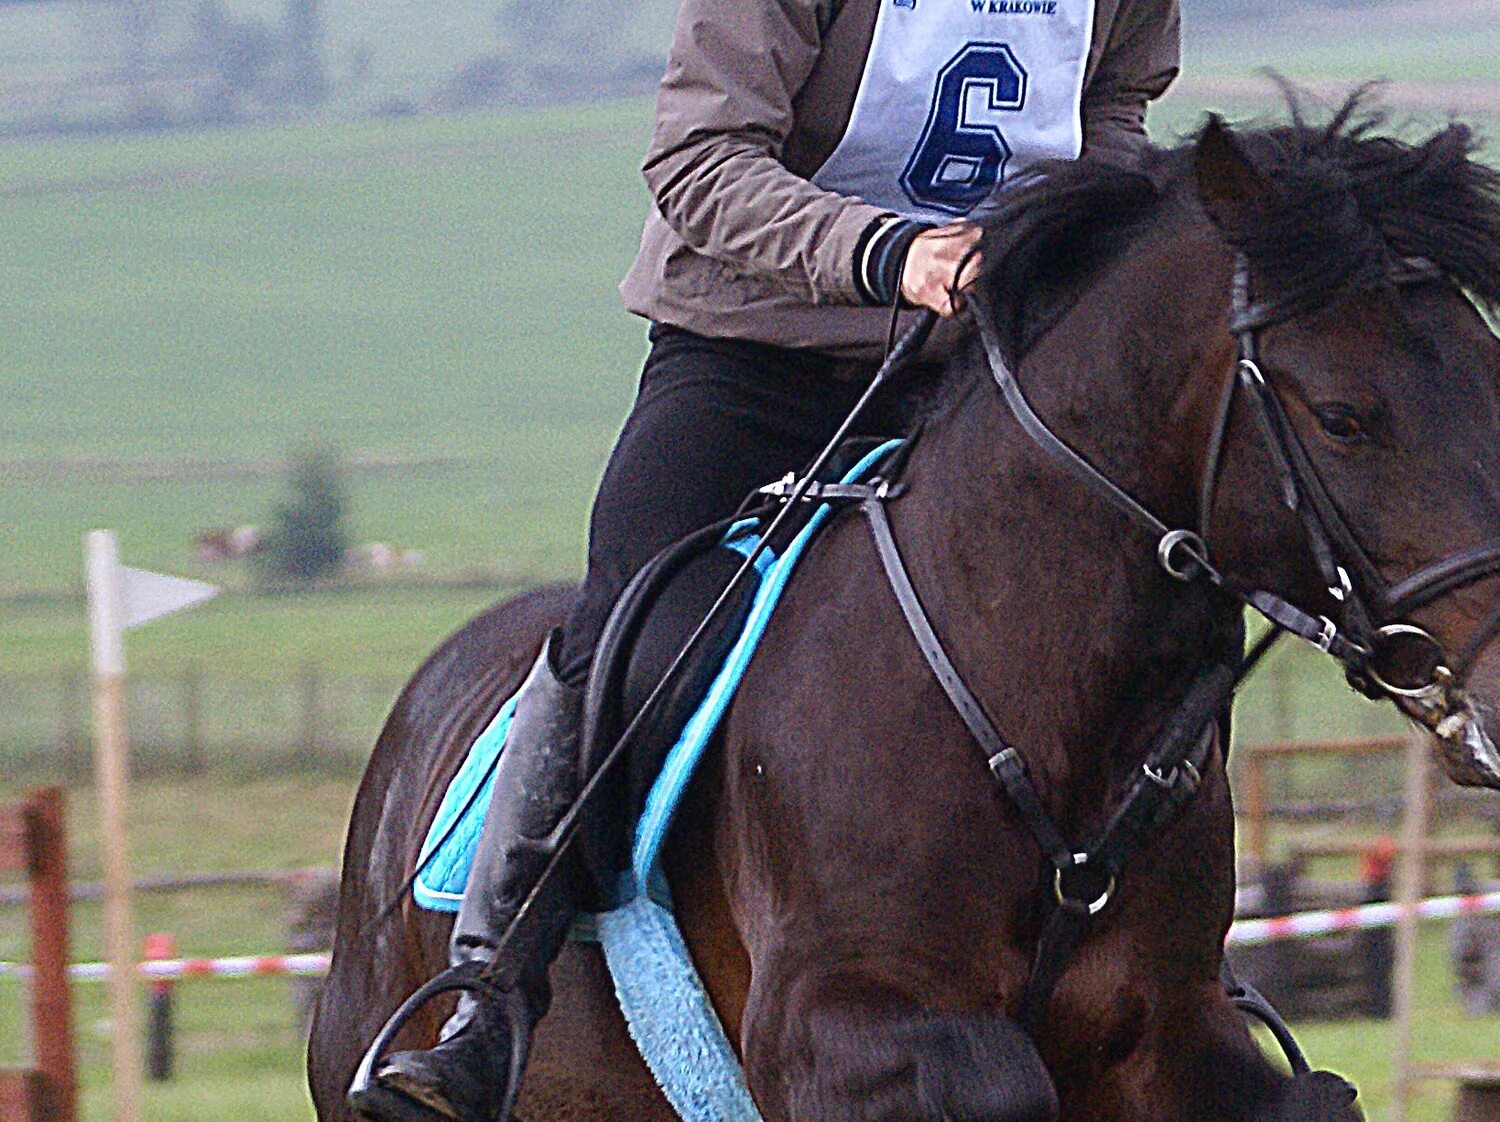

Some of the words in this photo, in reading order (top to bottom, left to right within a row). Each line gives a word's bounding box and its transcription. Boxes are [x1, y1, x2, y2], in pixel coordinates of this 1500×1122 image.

[971, 0, 986, 12] W
[988, 0, 1057, 14] KRAKOWIE
[898, 41, 1028, 216] 6
